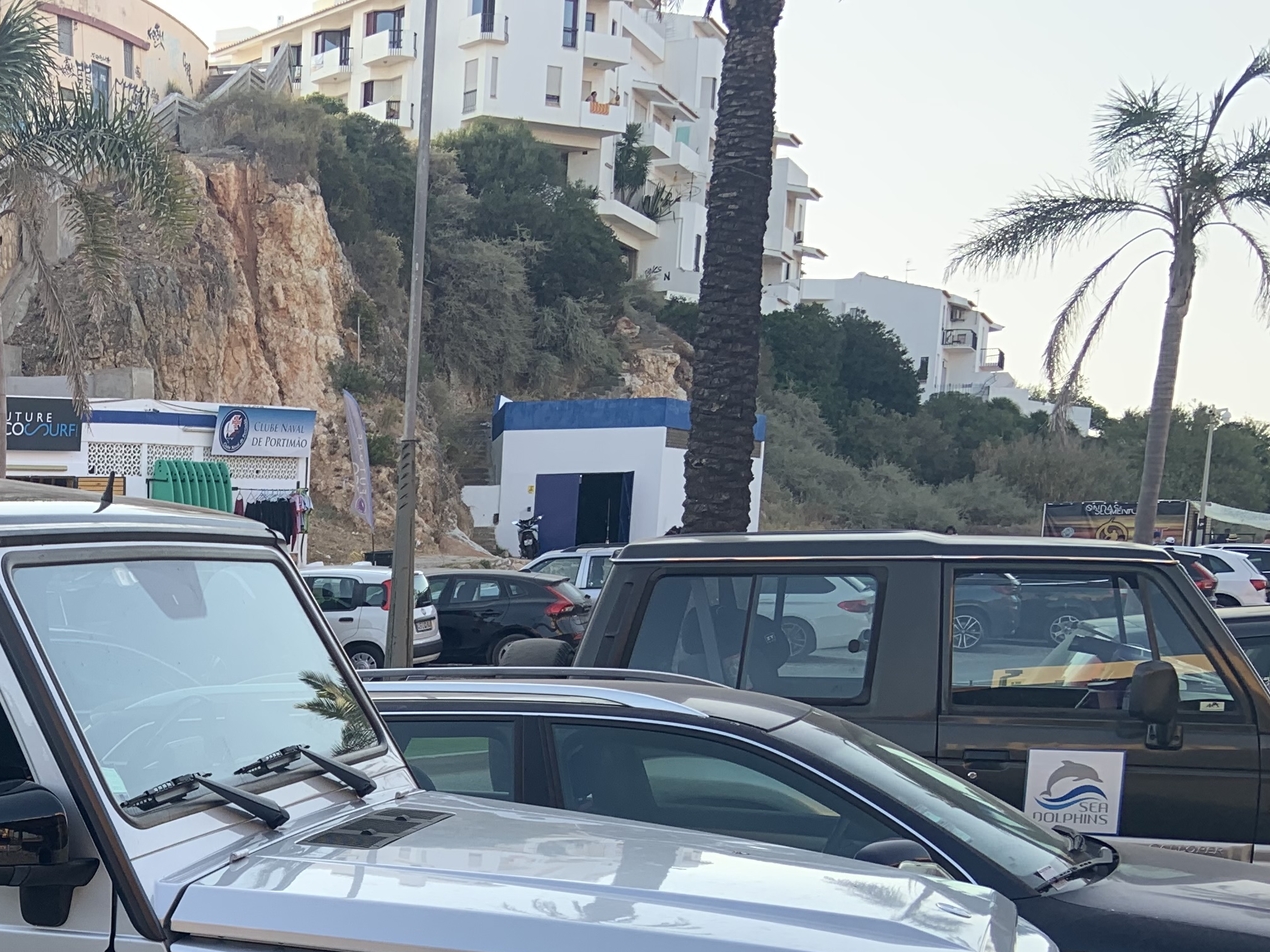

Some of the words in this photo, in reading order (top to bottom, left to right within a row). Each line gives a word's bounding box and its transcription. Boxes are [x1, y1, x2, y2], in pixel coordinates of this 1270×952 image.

[6, 411, 52, 423] UTURE
[1078, 801, 1109, 813] SEA
[1032, 811, 1108, 825] DOLPHINS
